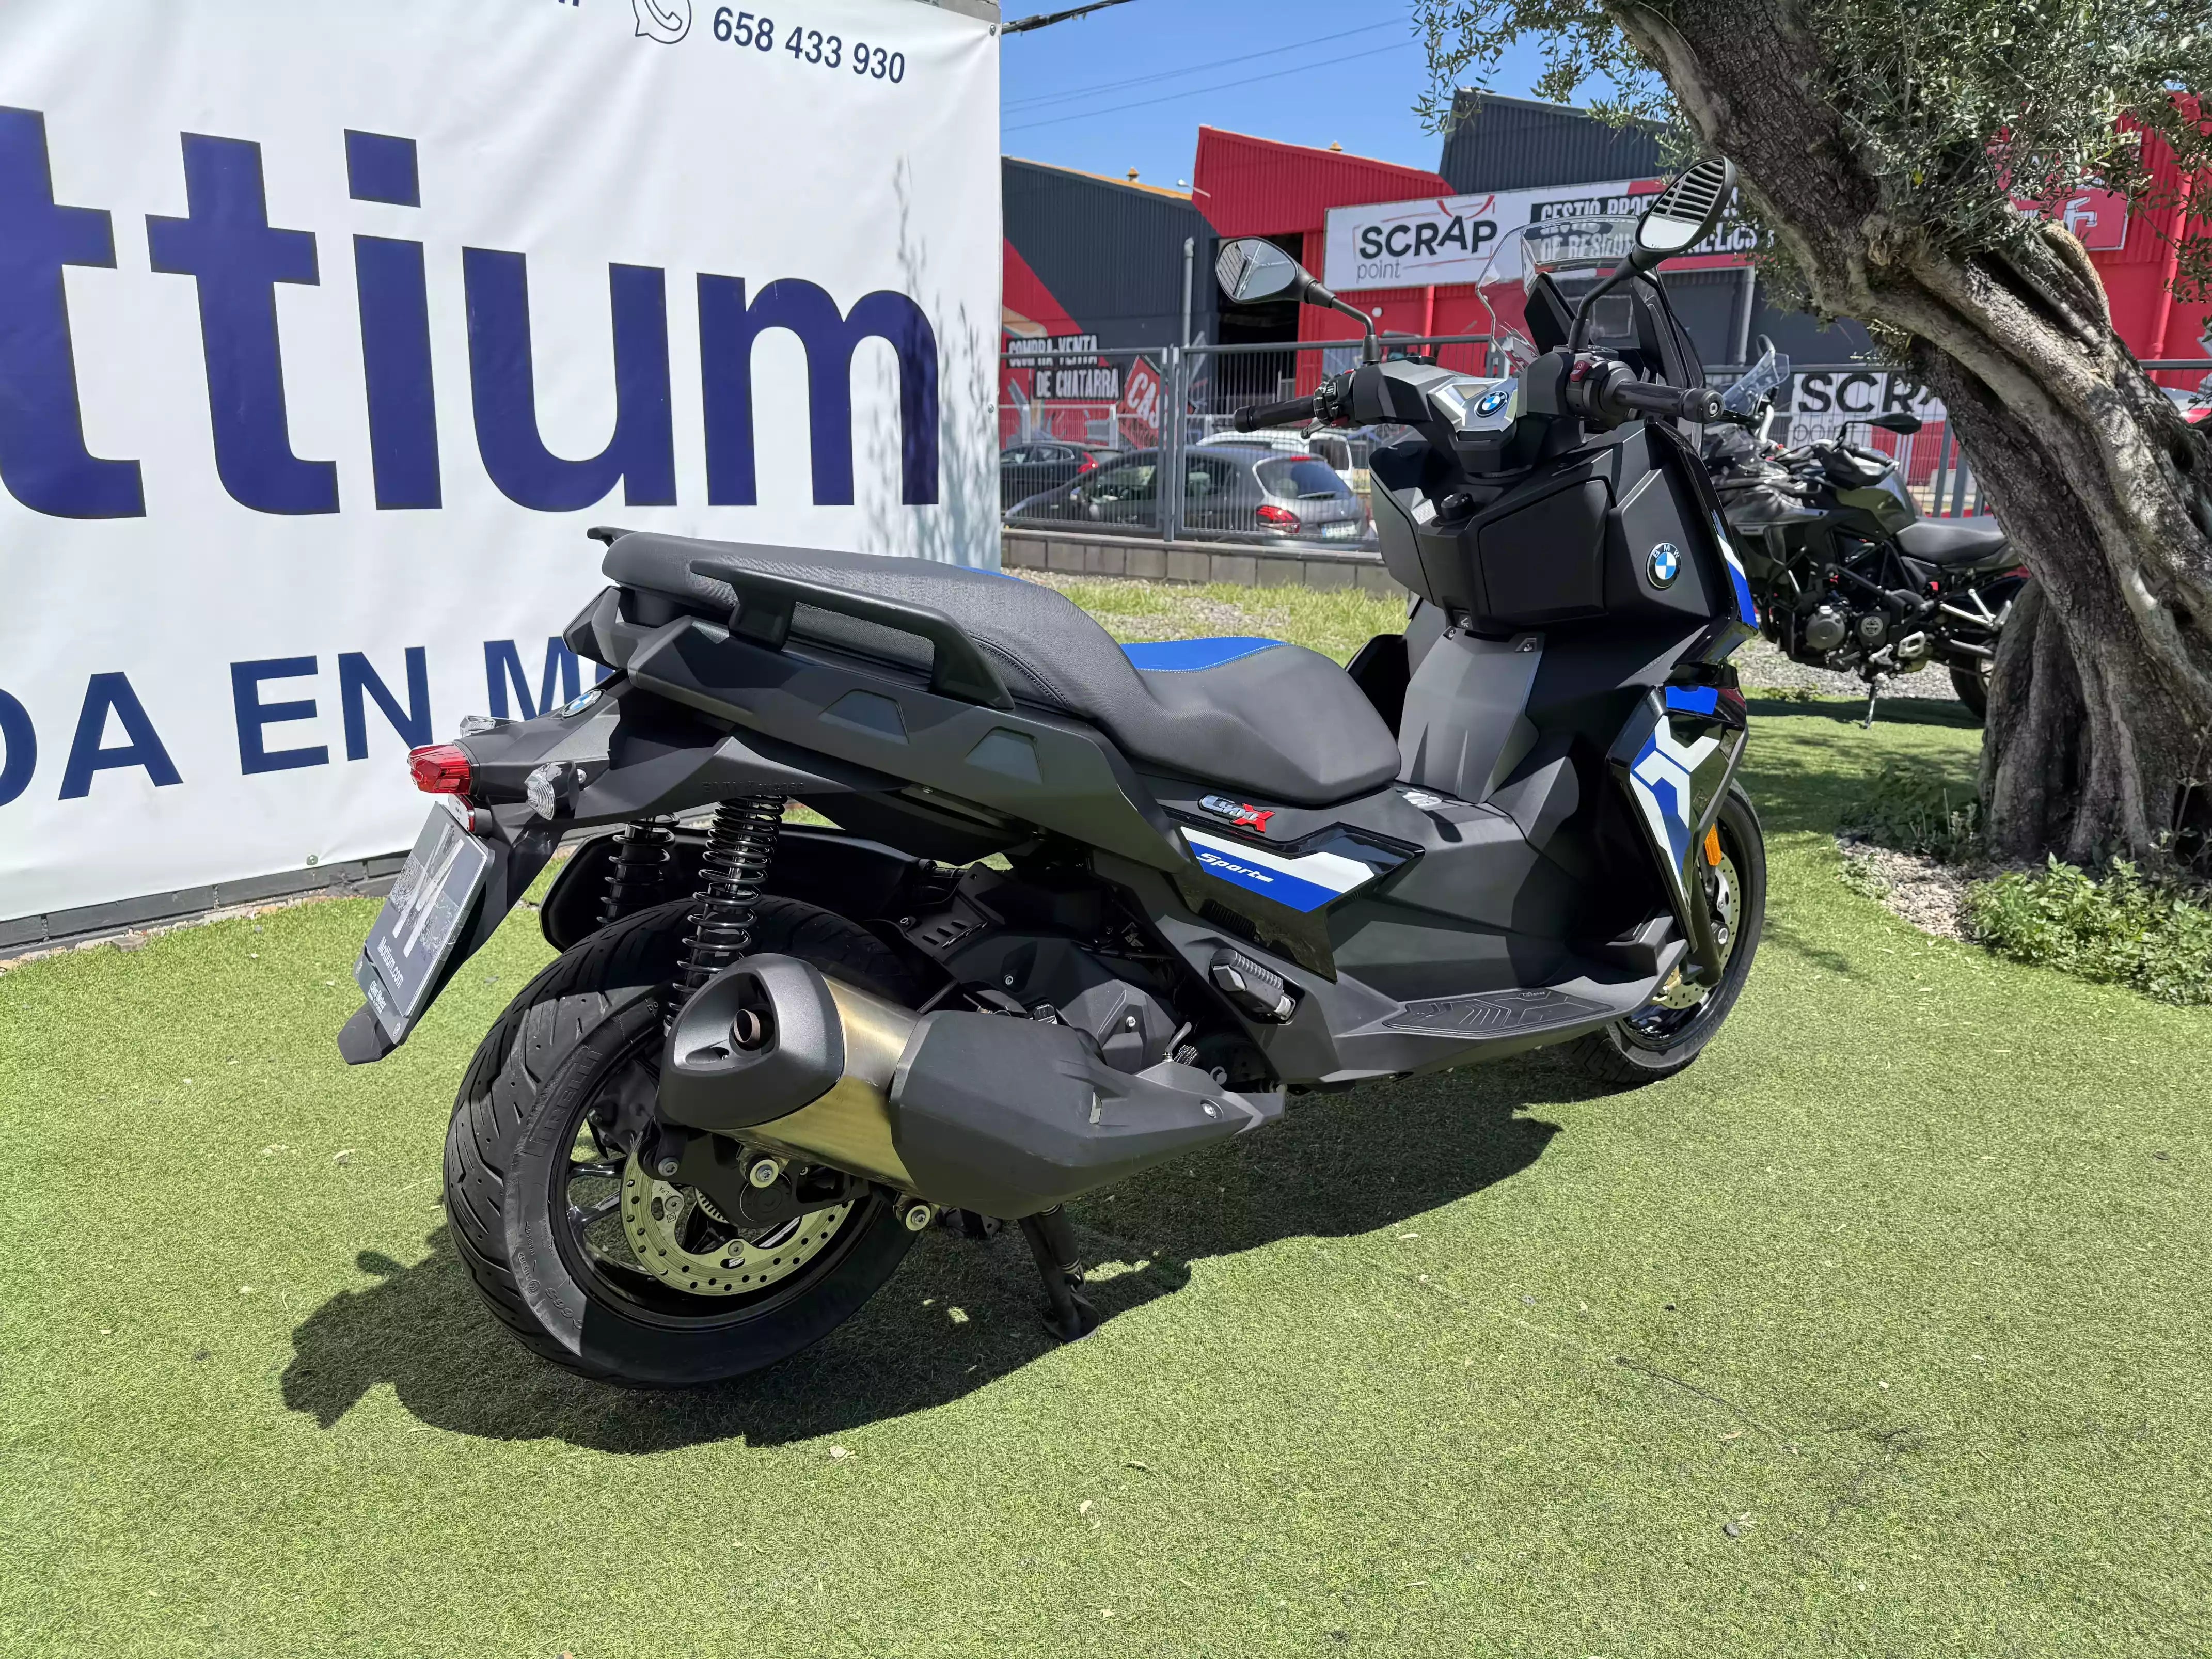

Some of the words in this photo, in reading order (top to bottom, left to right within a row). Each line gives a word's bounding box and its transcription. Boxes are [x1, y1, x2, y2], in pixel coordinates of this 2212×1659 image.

[713, 6, 775, 52] 658
[785, 26, 842, 68] 433
[852, 42, 905, 83] 930
[1360, 215, 1498, 259] SCRAP
[1356, 260, 1401, 284] point
[1036, 370, 1052, 398] DE
[1056, 368, 1120, 398] CHATARRA
[1798, 372, 1927, 413] SCR
[1652, 544, 1680, 559] BMW
[230, 646, 434, 776] EN
[1196, 852, 1271, 881] Sport
[519, 1048, 603, 1158] PIRELLI
